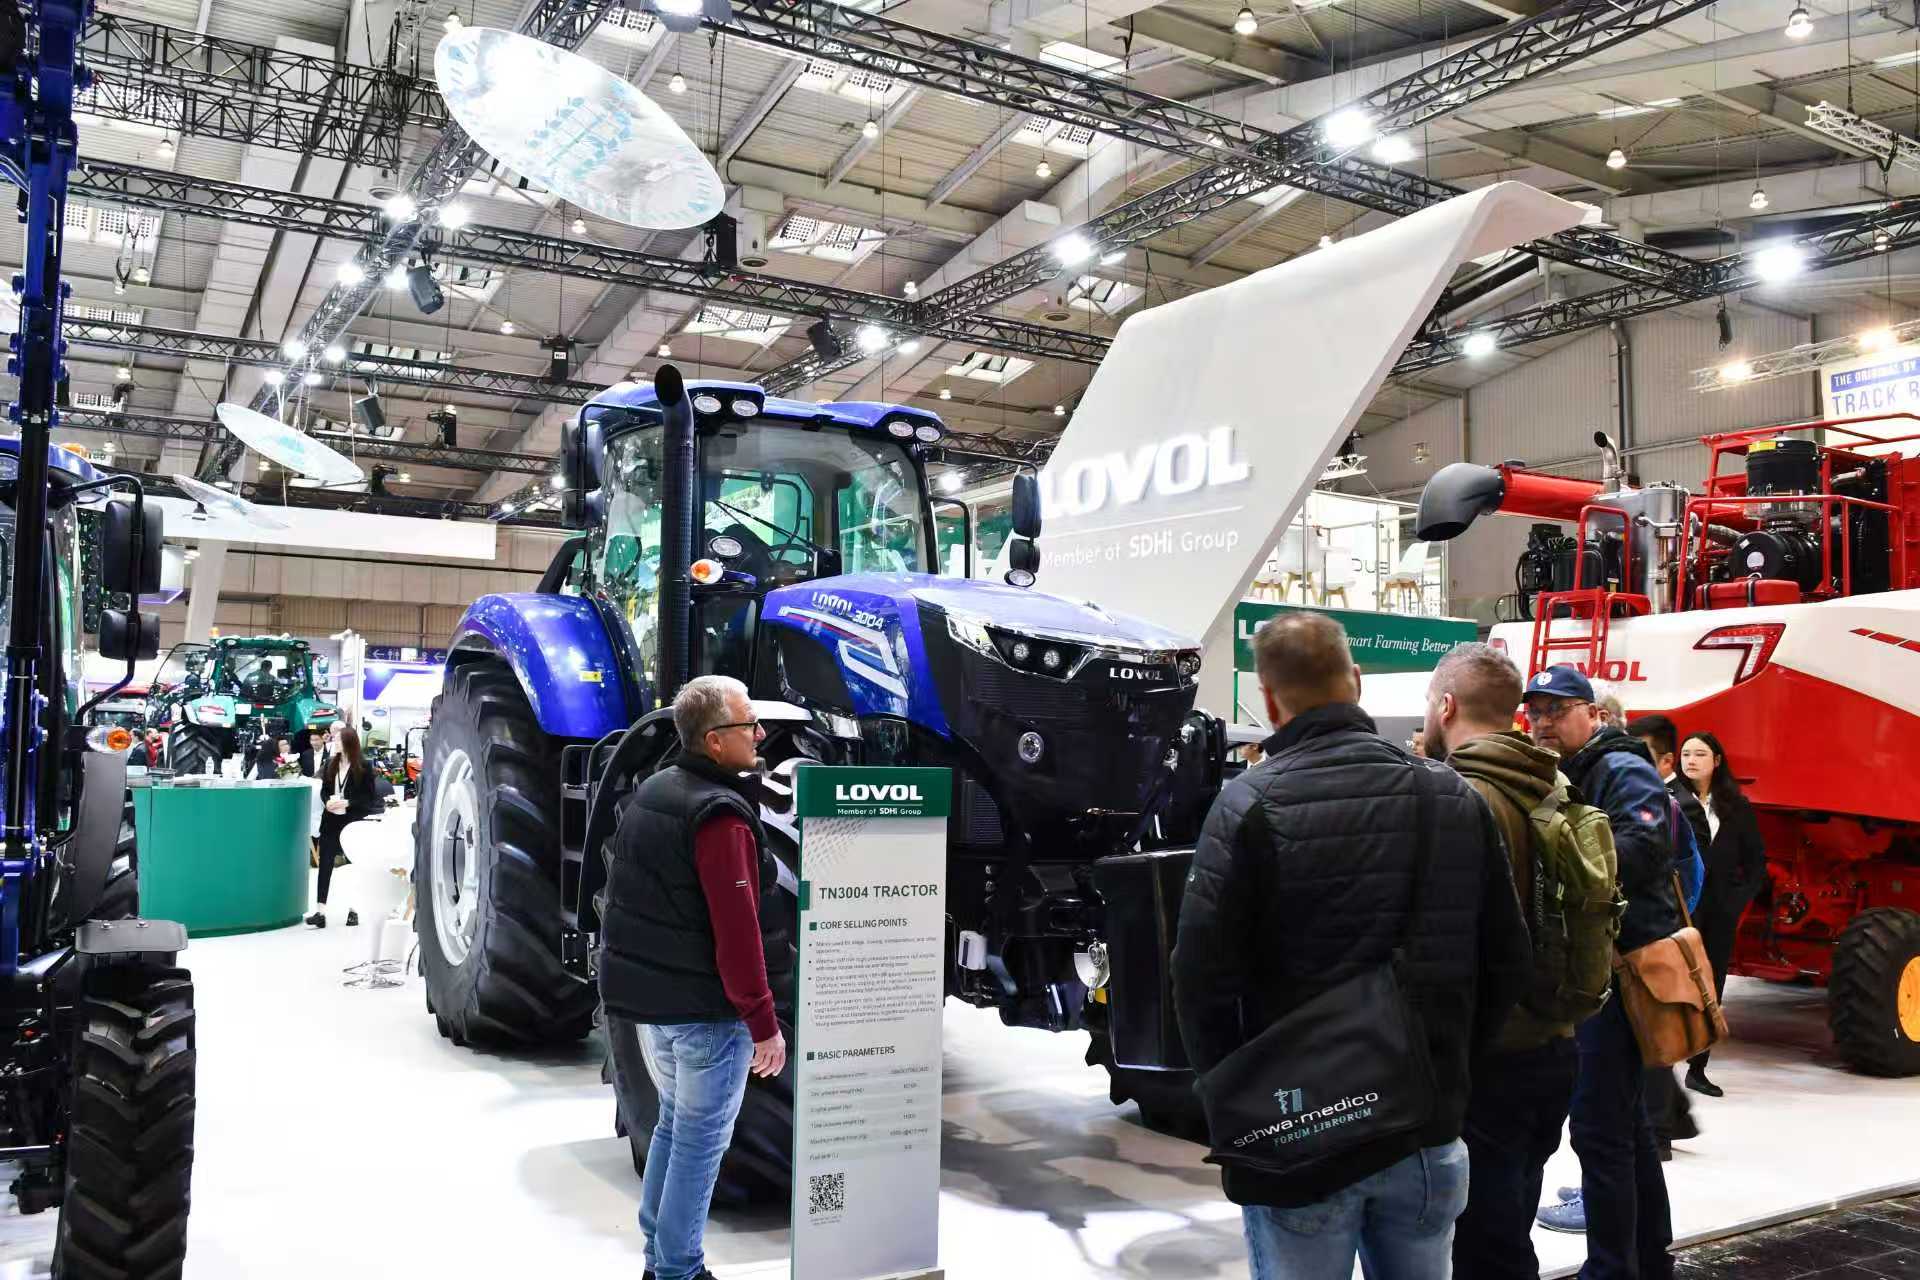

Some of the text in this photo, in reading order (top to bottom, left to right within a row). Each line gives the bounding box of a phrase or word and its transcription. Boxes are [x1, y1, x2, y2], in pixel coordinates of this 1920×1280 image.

[1833, 374, 1852, 387] THE
[1831, 384, 1897, 416] TRACK
[1038, 426, 1250, 520] LOVOL
[1042, 542, 1102, 569] Member
[1104, 543, 1121, 562] of
[1181, 529, 1240, 554] Group
[1375, 634, 1420, 656] Farming
[1421, 637, 1452, 654] Better
[1109, 667, 1165, 681] LOVOL
[1553, 661, 1648, 682] VOL
[835, 784, 924, 801] LOVOL
[837, 807, 867, 816] Member
[868, 807, 877, 815] of
[900, 807, 922, 816] Group
[819, 884, 938, 900] TN3004 TRACTOR
[820, 918, 908, 930] CORE SELLING POINTS
[817, 1045, 896, 1061] BASIC PARAMETERS
[1273, 1127, 1311, 1147] FORUM
